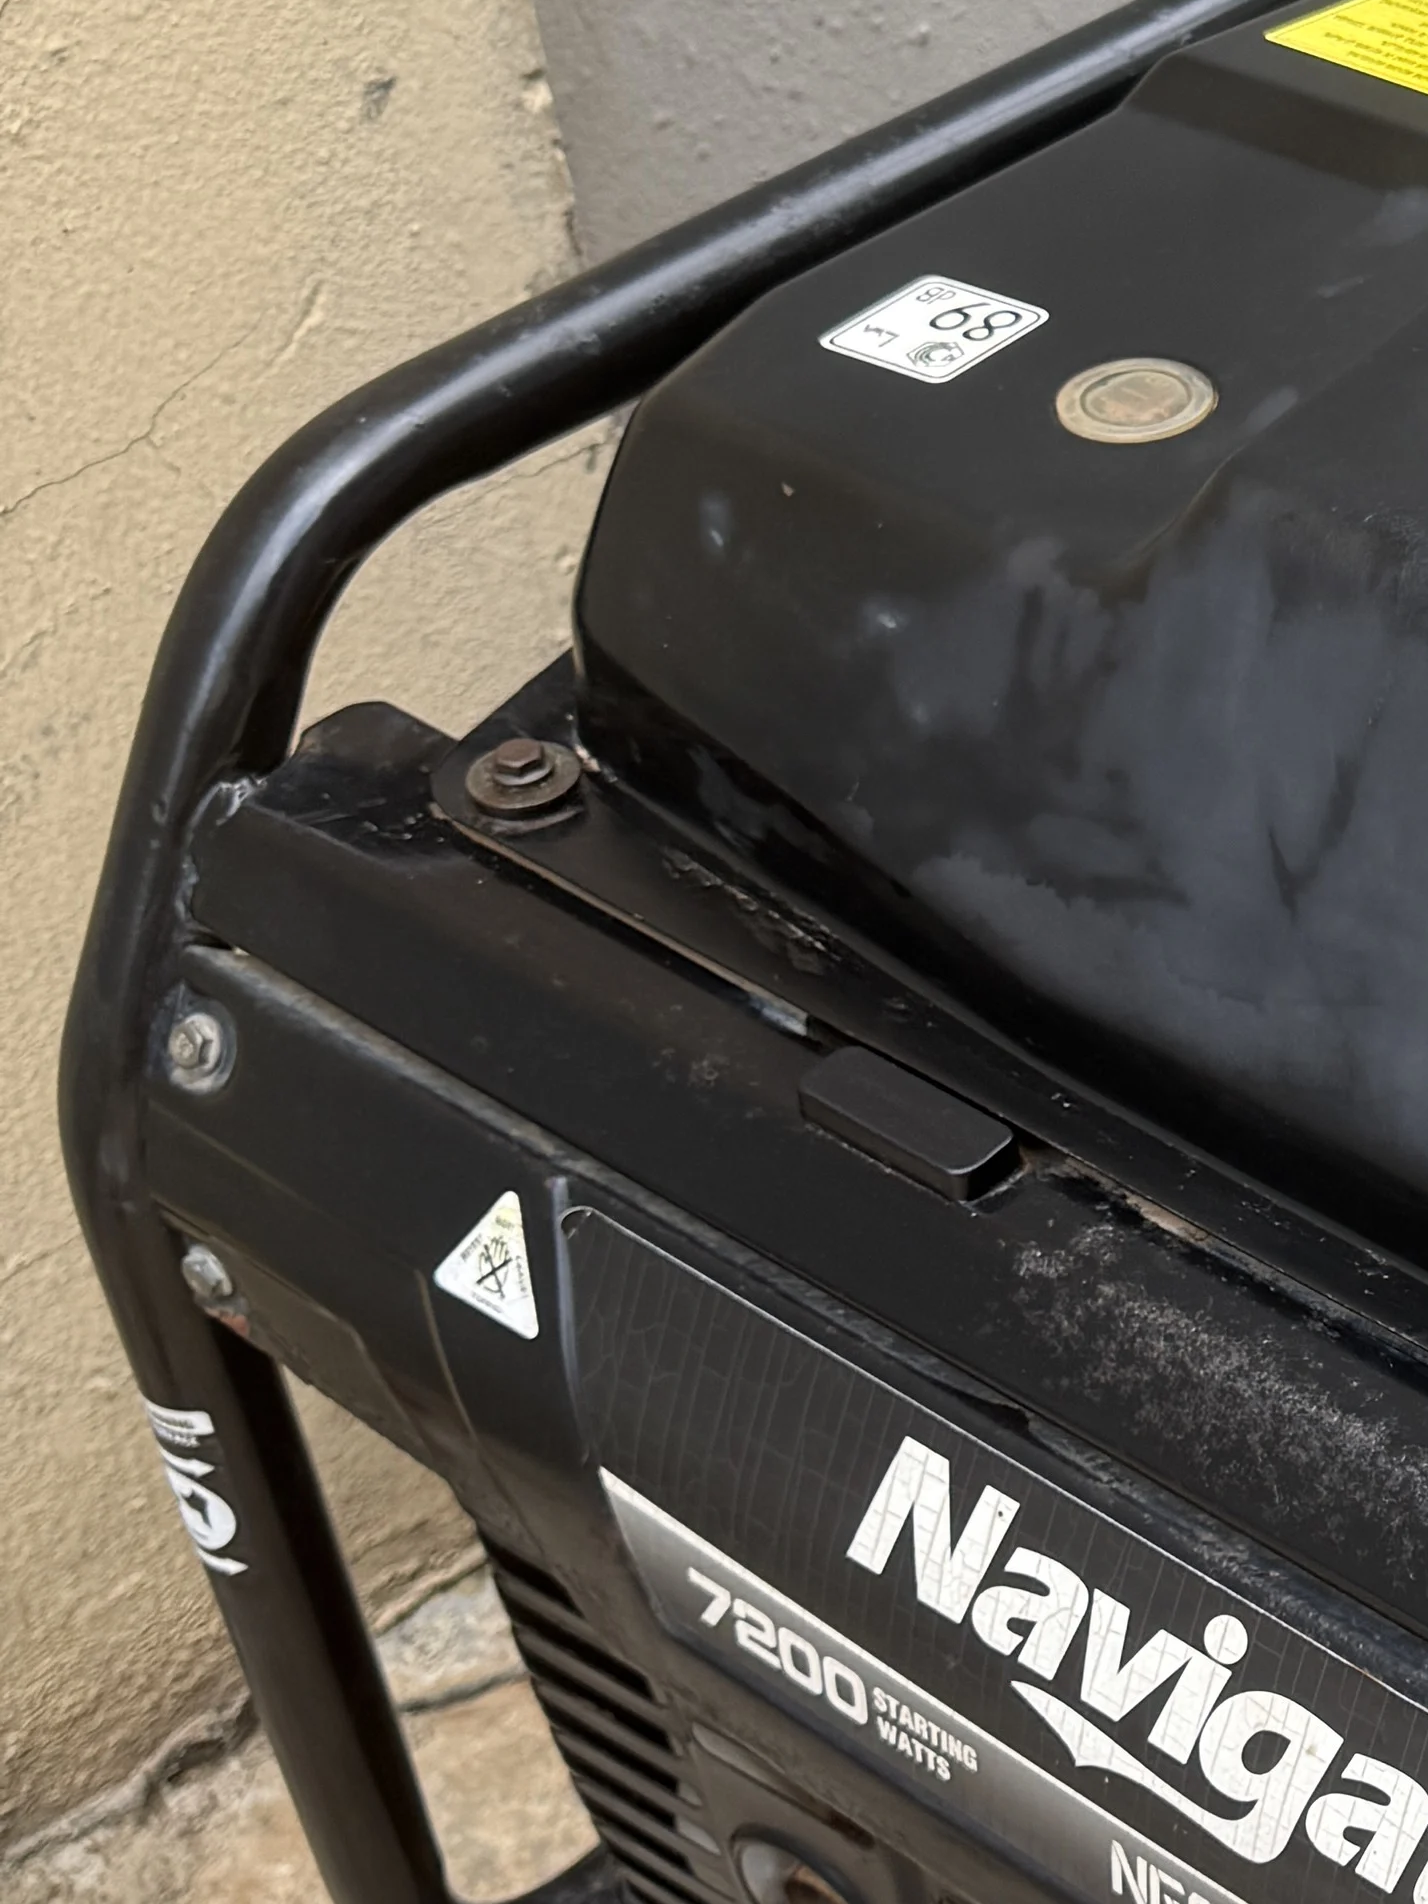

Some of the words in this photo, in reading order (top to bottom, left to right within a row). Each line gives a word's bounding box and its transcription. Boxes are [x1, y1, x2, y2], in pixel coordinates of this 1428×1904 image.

[928, 302, 1023, 342] 89
[687, 1565, 869, 1726] 7200
[872, 1686, 979, 1773] STARTING
[875, 1715, 952, 1782] WATTS
